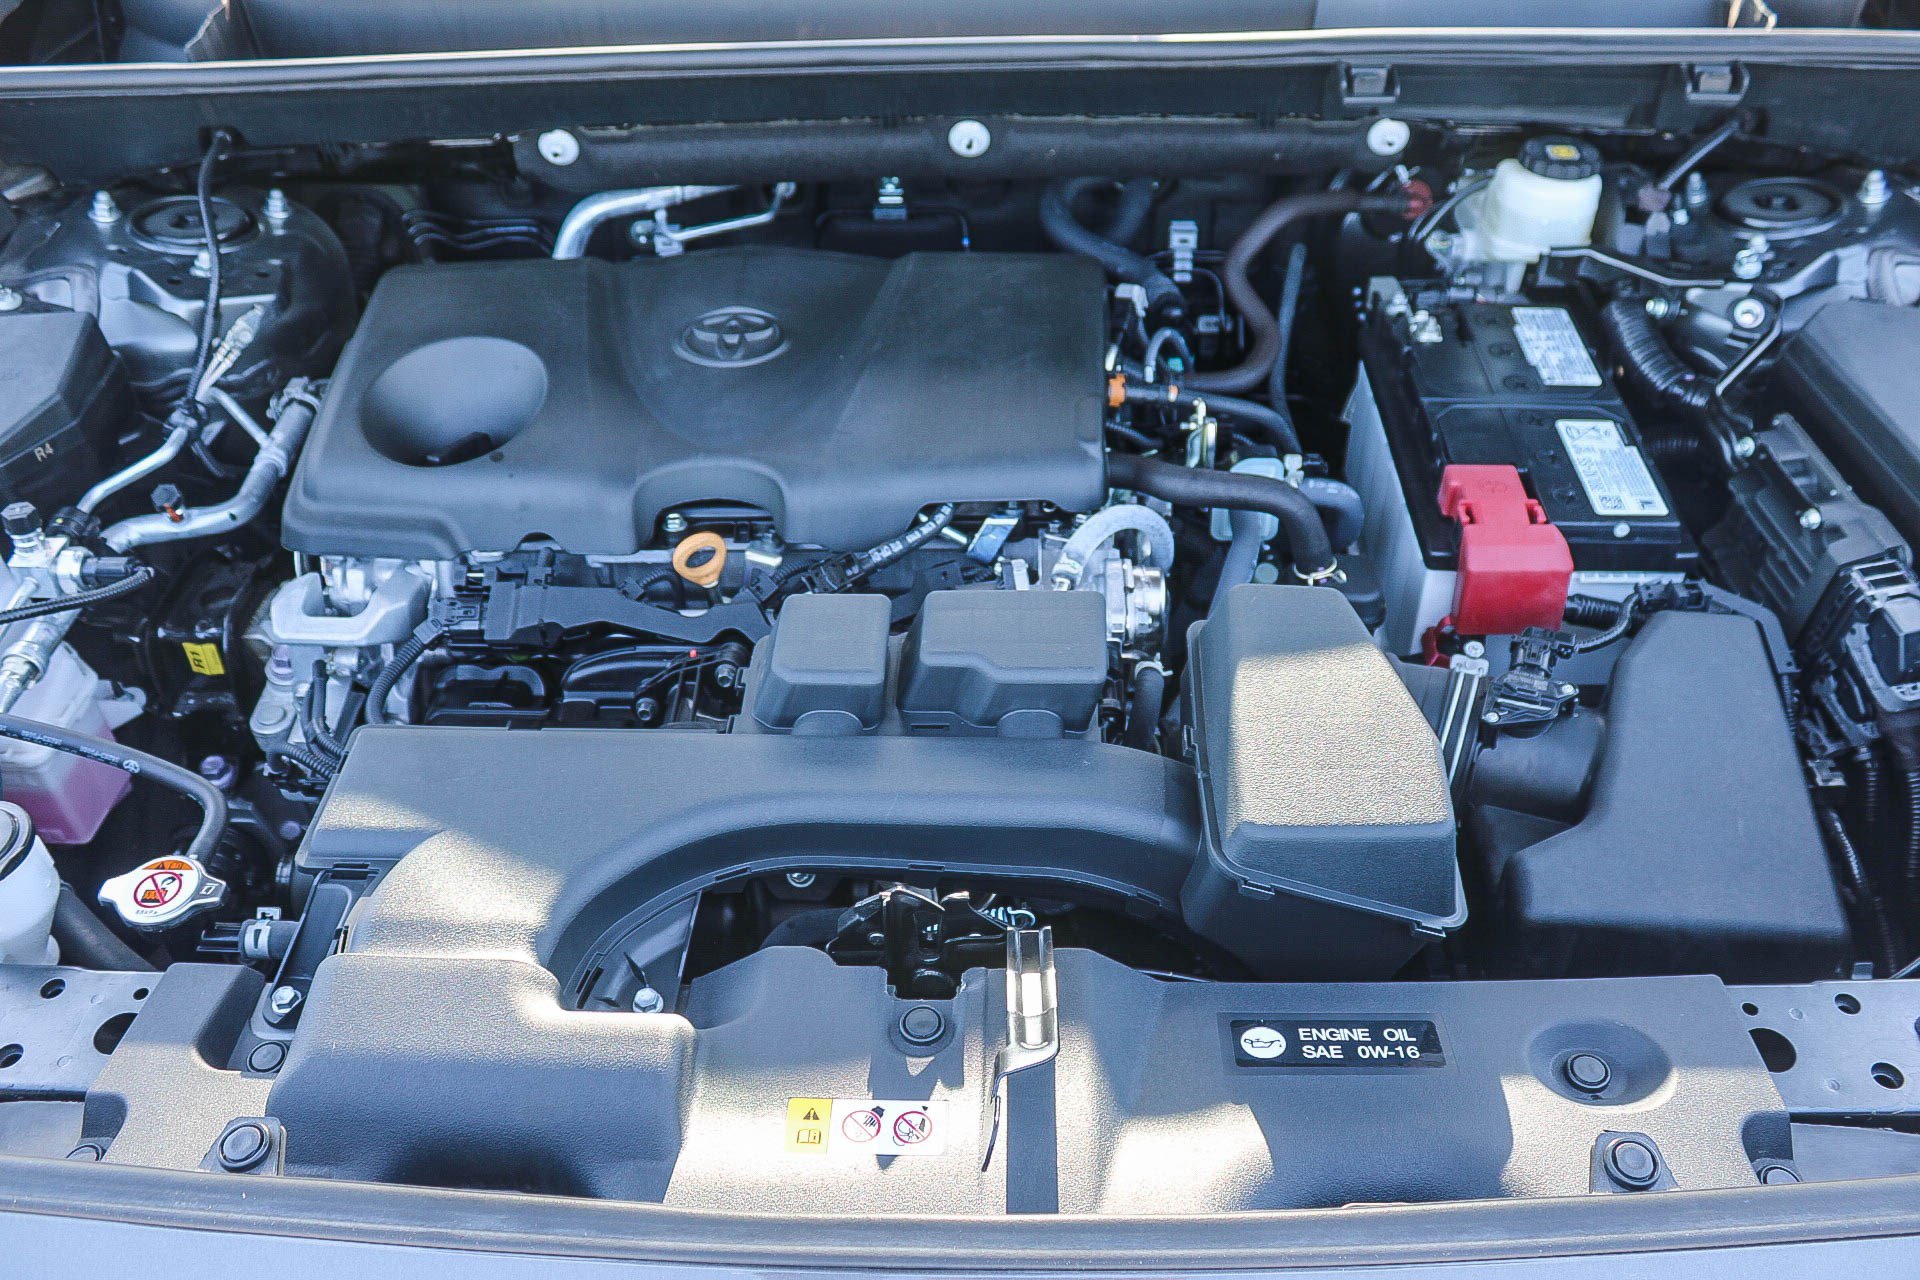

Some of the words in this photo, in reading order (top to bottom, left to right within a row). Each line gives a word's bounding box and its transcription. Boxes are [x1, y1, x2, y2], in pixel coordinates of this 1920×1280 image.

[34, 443, 54, 462] R4
[190, 650, 205, 669] R1
[1298, 1028, 1371, 1041] ENGINE
[1383, 1028, 1416, 1042] OIL
[1302, 1045, 1344, 1058] SAE
[1357, 1045, 1420, 1059] 0W-16
